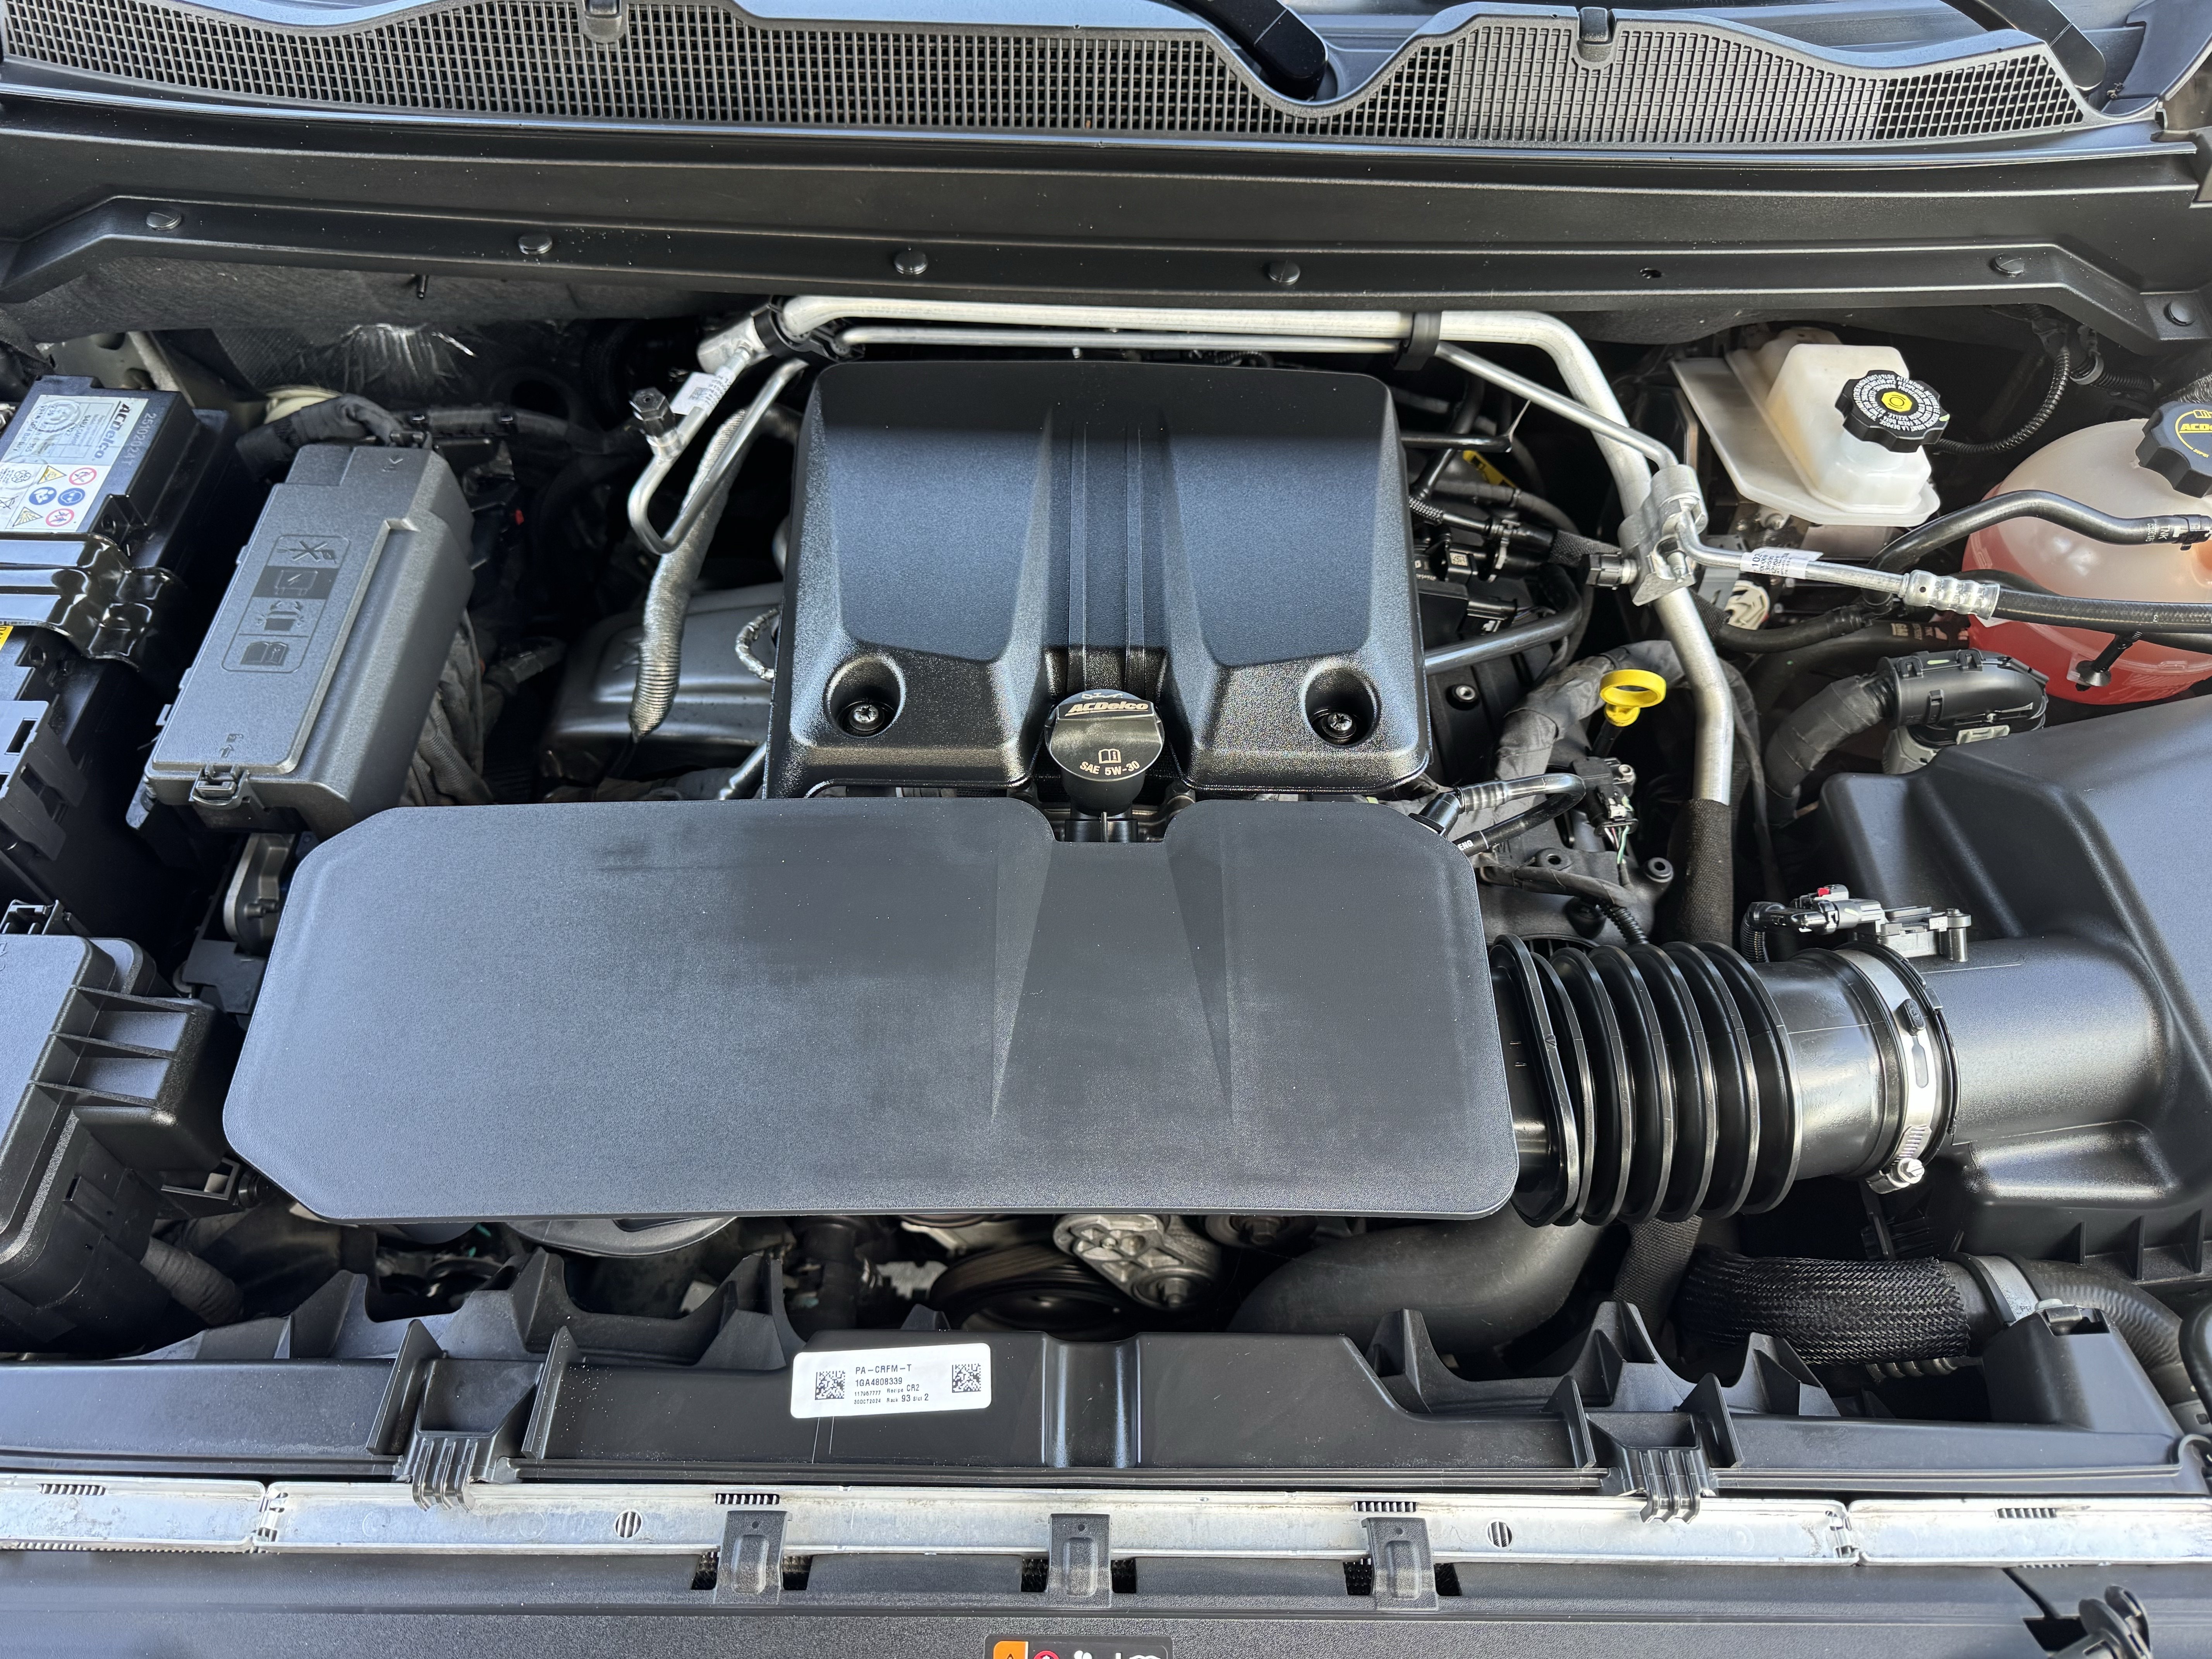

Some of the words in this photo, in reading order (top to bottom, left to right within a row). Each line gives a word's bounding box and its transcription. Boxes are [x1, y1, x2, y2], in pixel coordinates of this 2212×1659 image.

[94, 403, 131, 459] ACDelco
[2158, 525, 2170, 539] TNK
[1068, 701, 1149, 713] ACDelco
[1080, 761, 1100, 774] SAE
[1105, 761, 1140, 776] 5W-30
[1457, 840, 1474, 851] ENG
[856, 1364, 912, 1374] PA-CRFM-T
[855, 1377, 902, 1387] 1GA4808339
